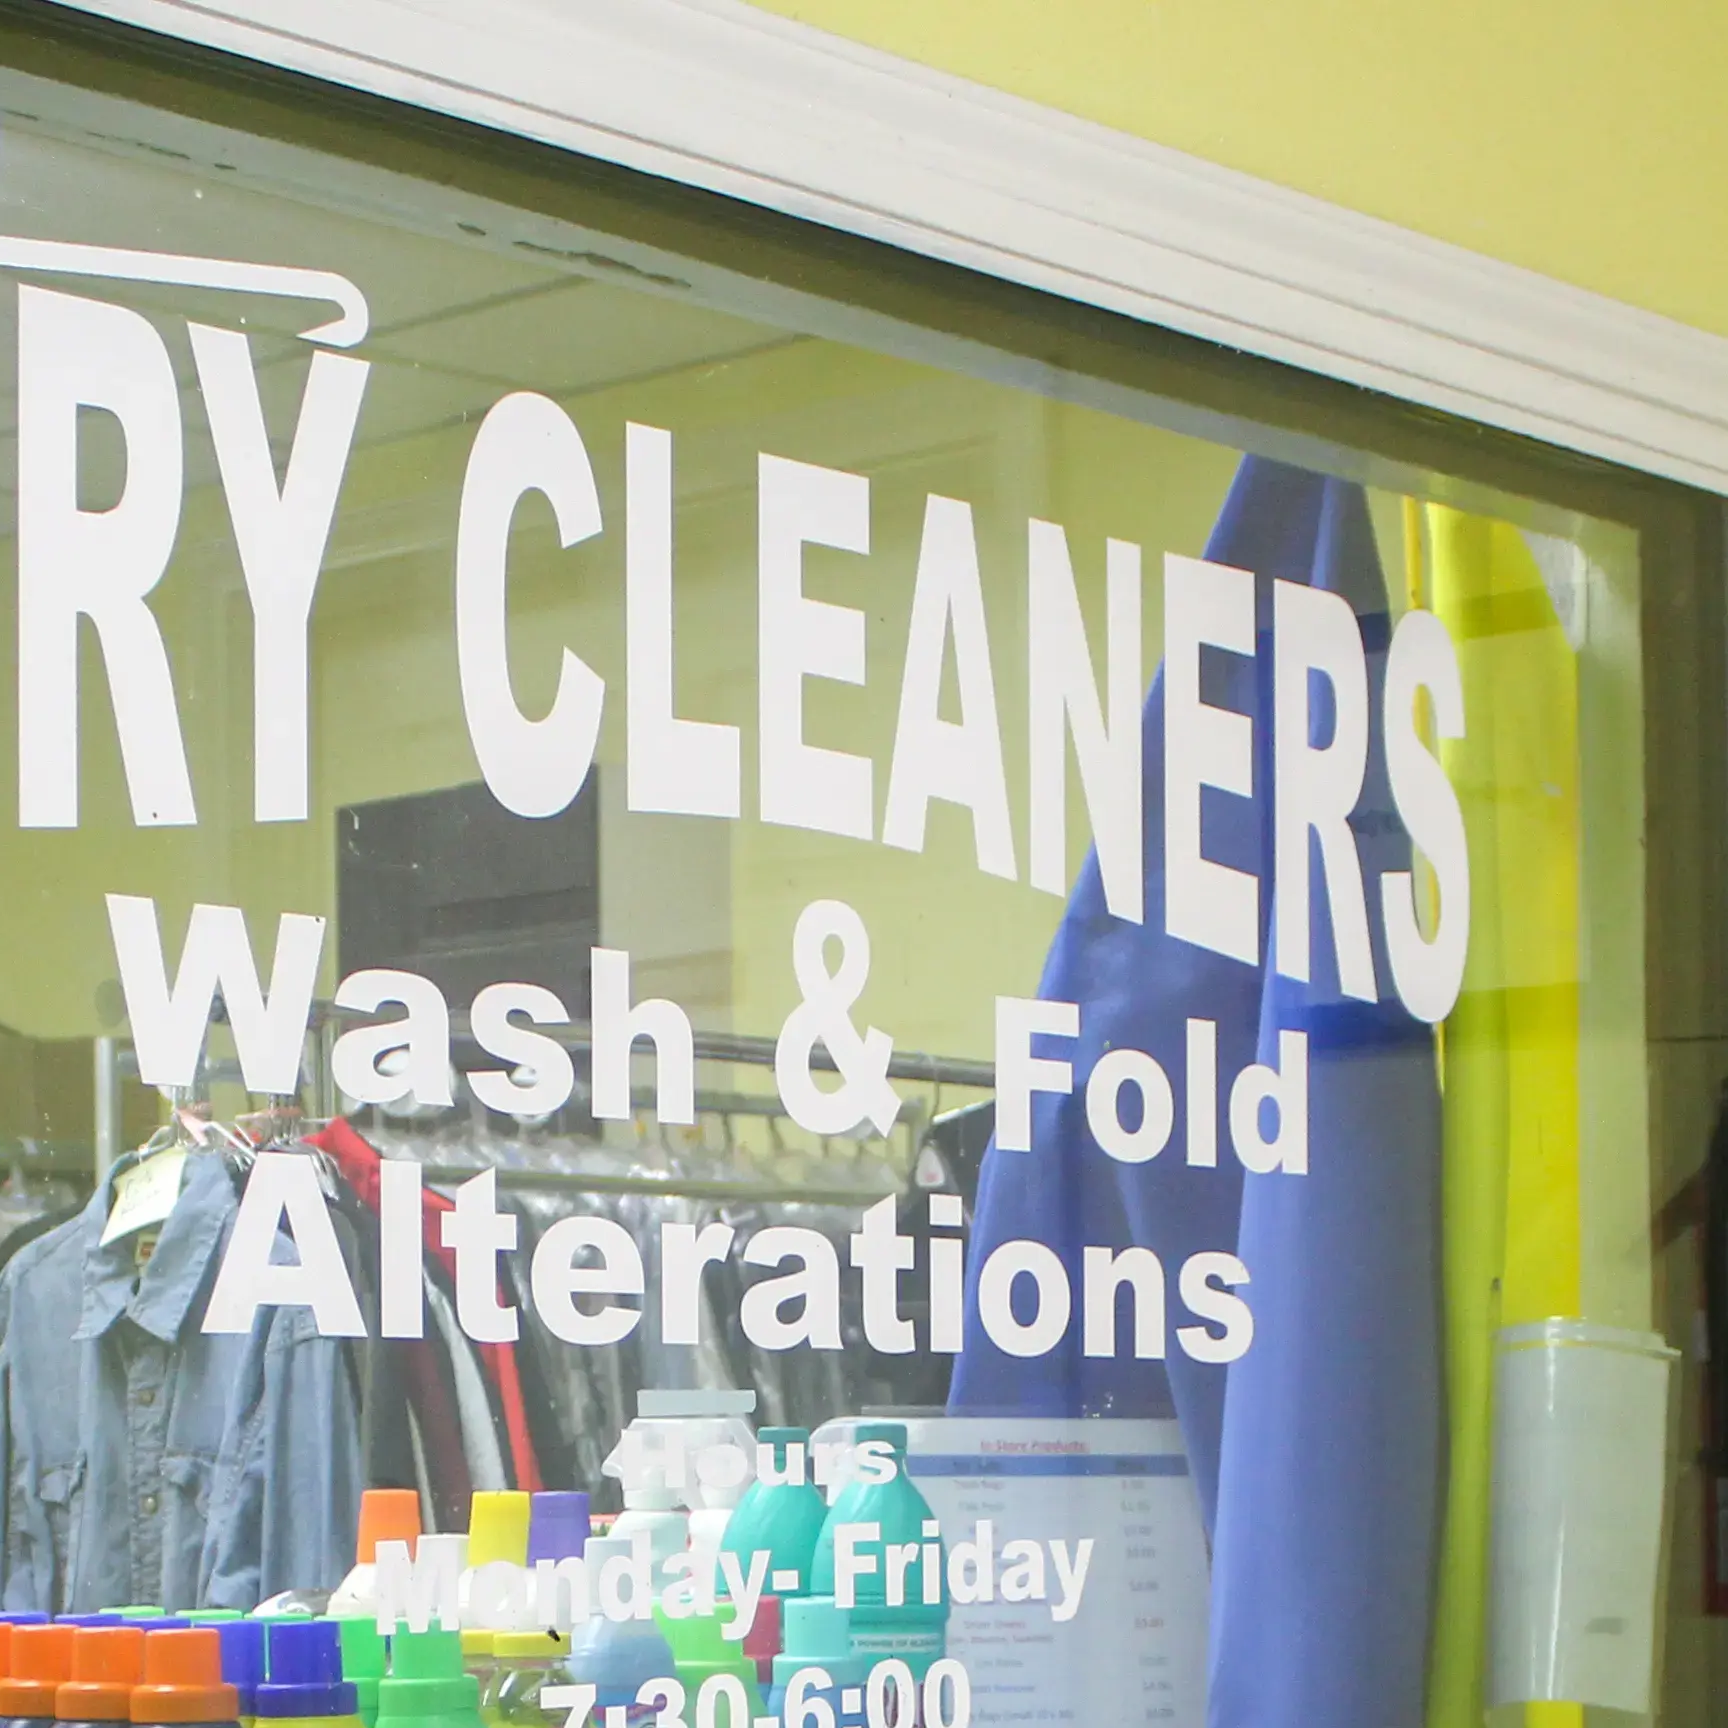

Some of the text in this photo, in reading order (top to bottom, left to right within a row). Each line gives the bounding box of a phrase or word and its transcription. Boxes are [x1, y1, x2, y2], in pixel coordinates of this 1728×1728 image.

[455, 391, 1470, 1024] CLEANERS
[104, 893, 1308, 1174] Wash & Fold
[202, 1150, 1256, 1364] Alterations
[622, 1428, 899, 1488] Hours
[833, 1520, 1094, 1622] Friday
